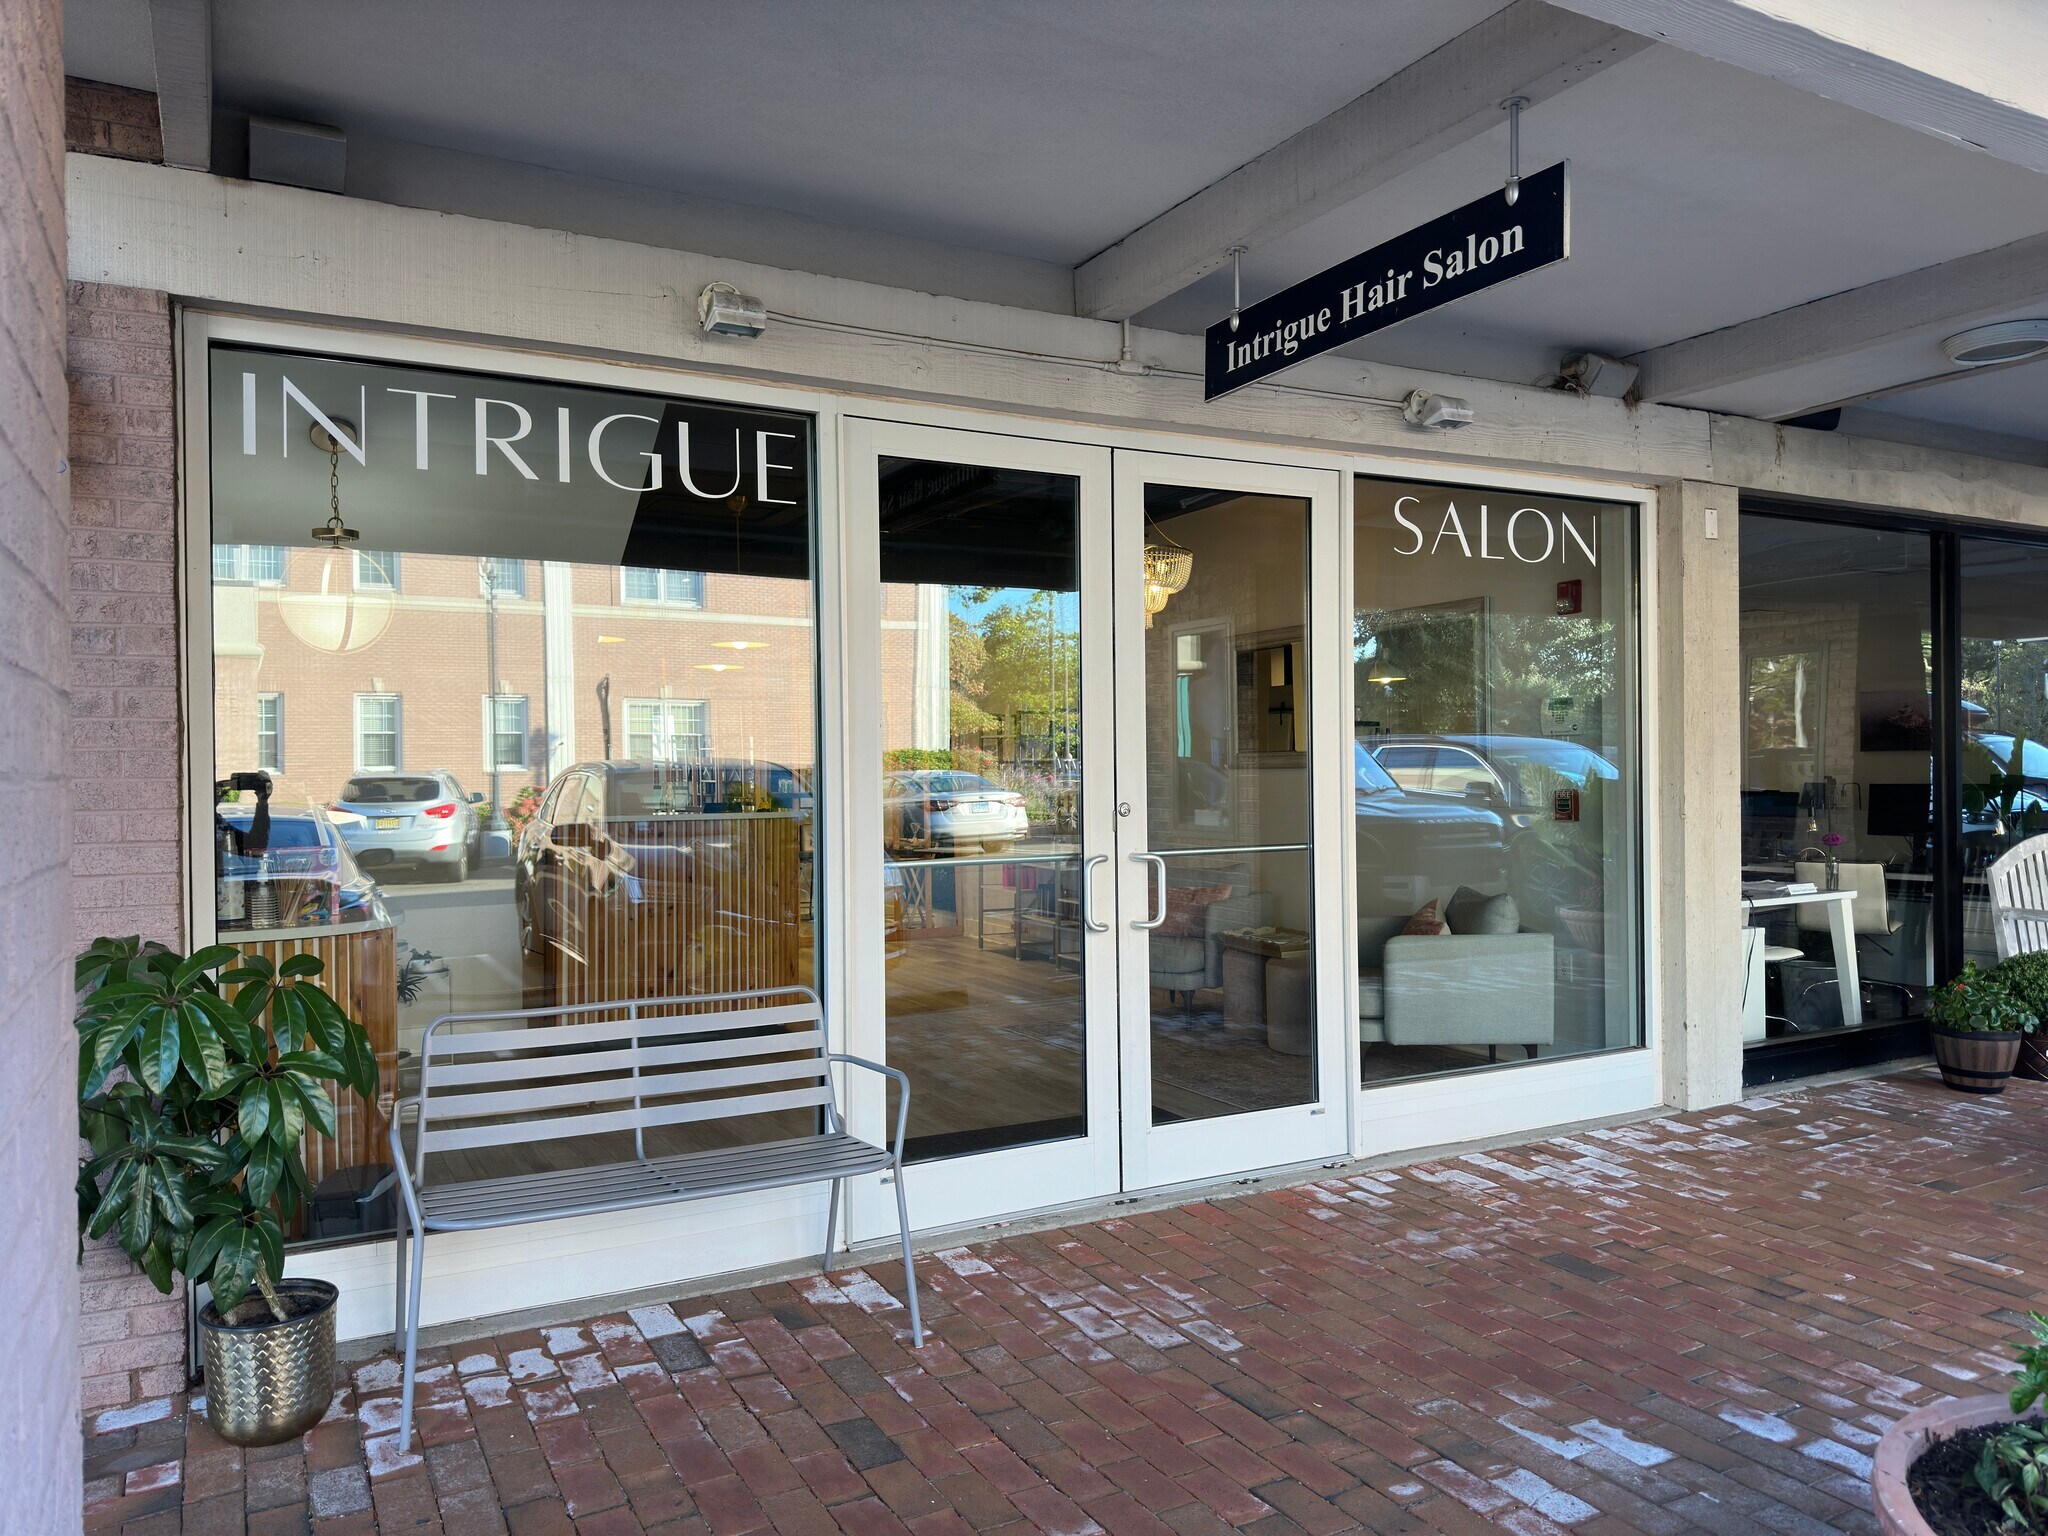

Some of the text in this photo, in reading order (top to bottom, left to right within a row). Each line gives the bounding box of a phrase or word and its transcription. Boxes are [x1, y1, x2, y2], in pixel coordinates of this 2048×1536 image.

[1226, 225, 1525, 373] Intrigue Hair Salon
[242, 372, 797, 505] INTRIGUE
[1393, 496, 1597, 567] SALON
